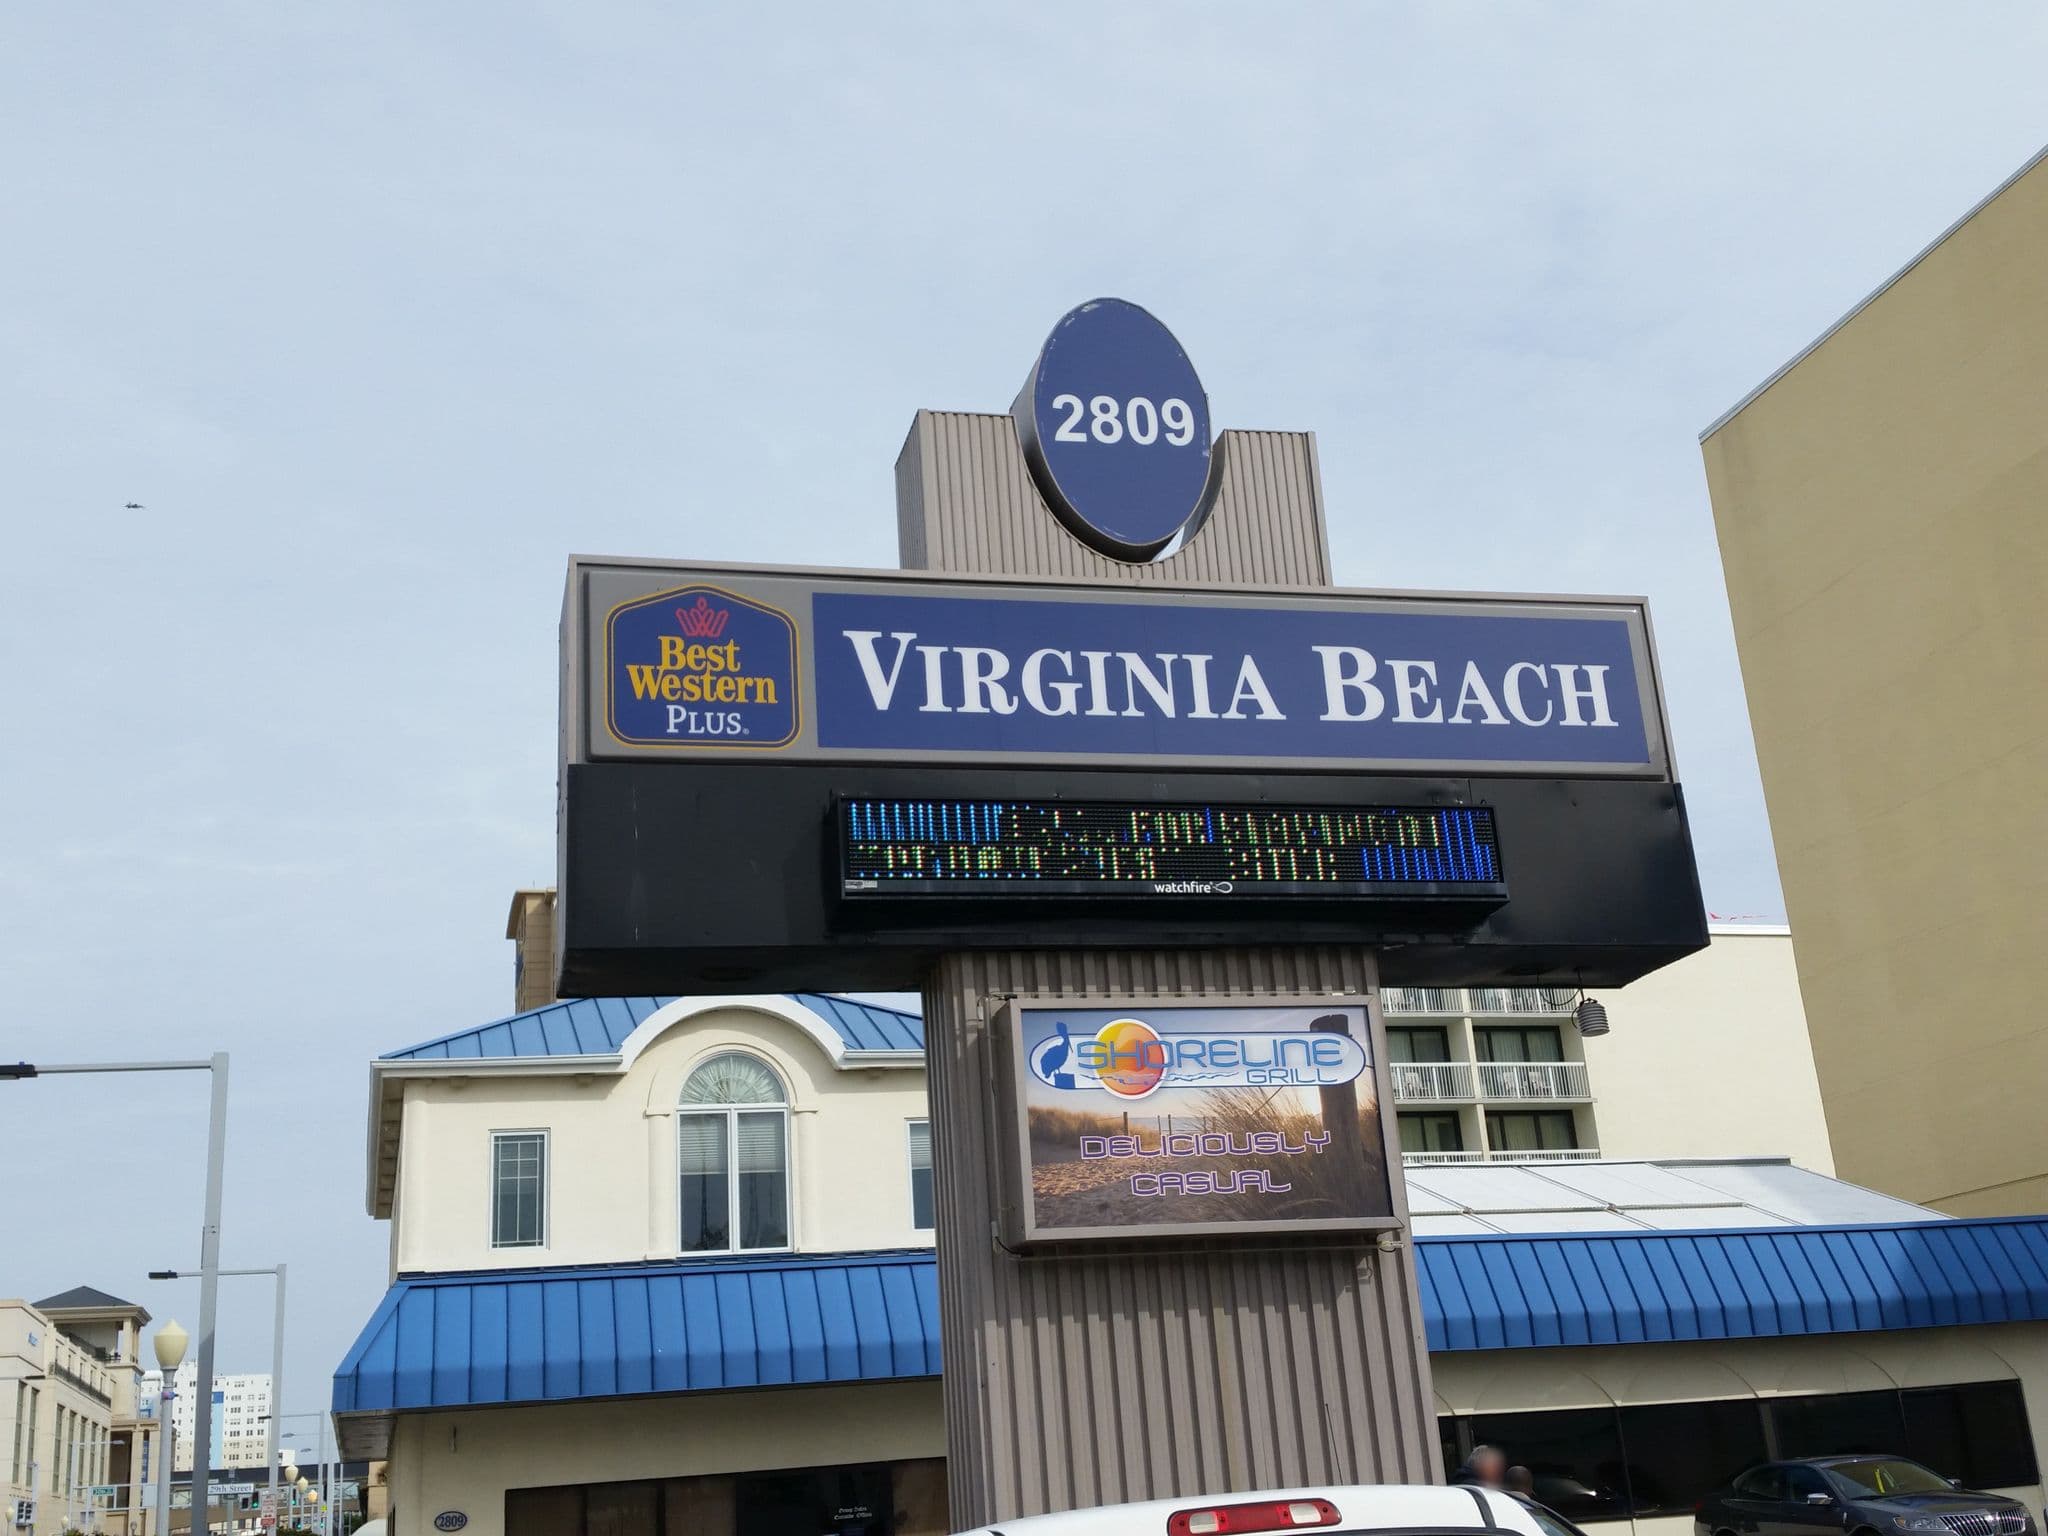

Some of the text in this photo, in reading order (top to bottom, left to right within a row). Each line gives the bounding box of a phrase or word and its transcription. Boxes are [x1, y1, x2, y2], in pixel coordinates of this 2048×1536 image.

[1052, 393, 1195, 446] 2809
[657, 635, 741, 672] Best
[626, 664, 778, 704] Western
[842, 629, 1620, 727] VIRGINIA BEACH
[1154, 881, 1212, 893] watchfire
[1076, 1038, 1344, 1069] SHORELINE
[1246, 1067, 1338, 1085] GRILL
[1079, 1130, 1332, 1160] DELICIOUSLY
[1130, 1170, 1292, 1196] CASUAL
[230, 1484, 252, 1492] Street
[439, 1515, 464, 1528] 2809
